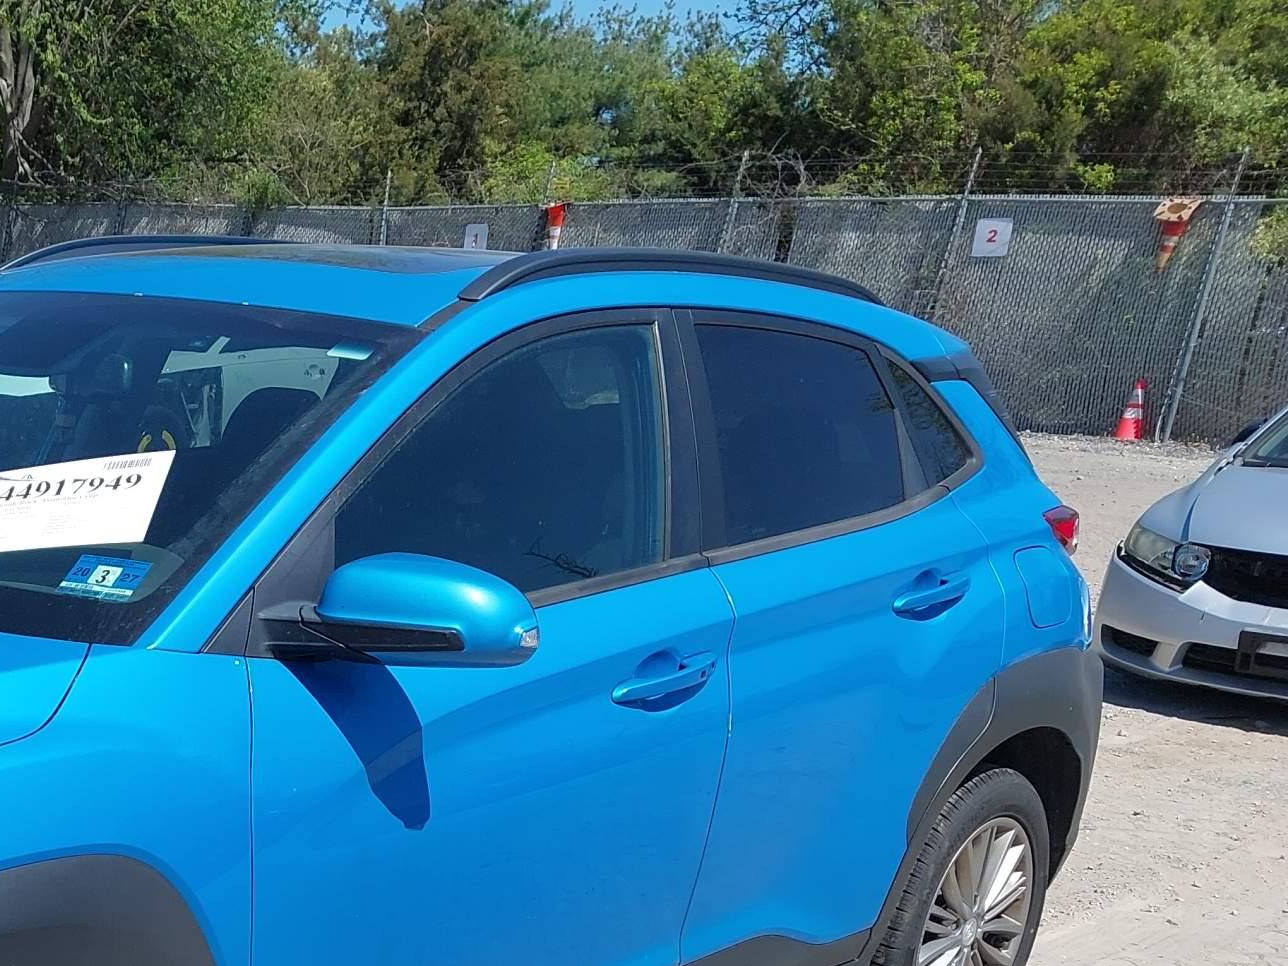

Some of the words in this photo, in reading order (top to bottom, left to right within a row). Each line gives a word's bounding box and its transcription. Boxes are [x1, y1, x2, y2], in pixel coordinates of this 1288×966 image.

[986, 229, 998, 243] 2
[73, 567, 91, 577] 20
[95, 569, 110, 584] 3
[119, 573, 140, 583] 27
